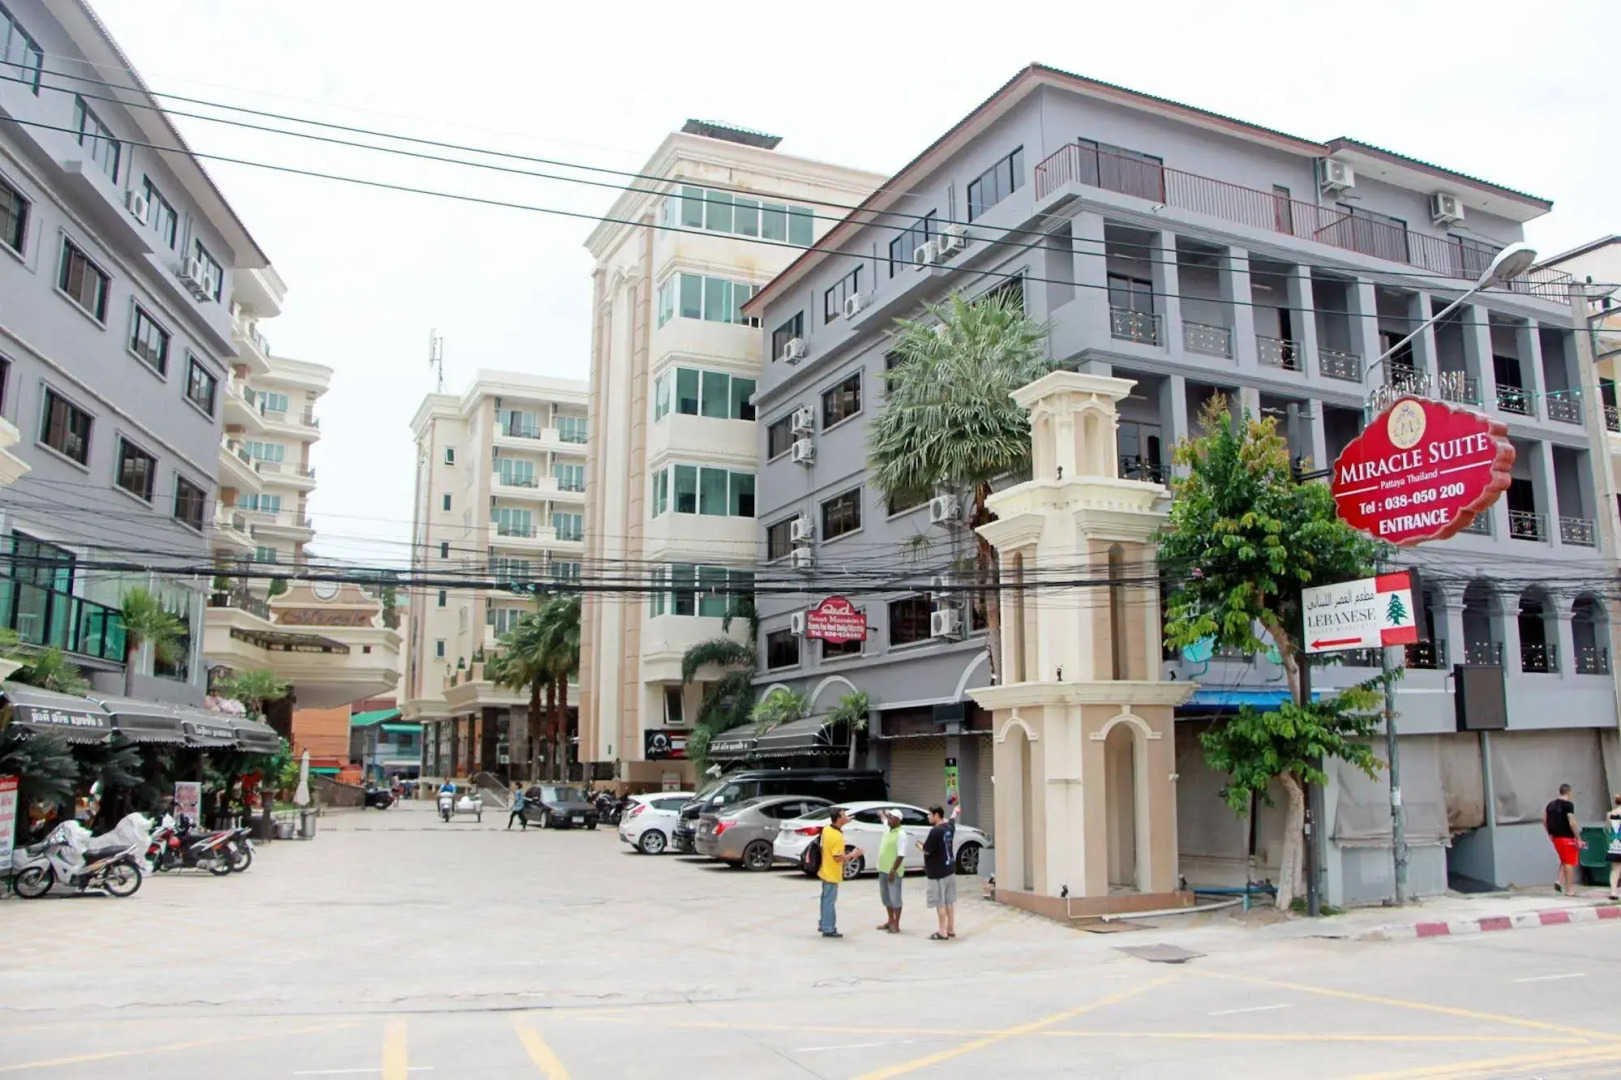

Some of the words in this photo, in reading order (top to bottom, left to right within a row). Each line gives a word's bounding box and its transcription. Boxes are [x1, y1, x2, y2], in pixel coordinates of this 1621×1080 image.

[1340, 449, 1423, 485] MIRACLE
[1428, 432, 1488, 464] SUITE
[1380, 478, 1405, 490] Pattaya
[1407, 469, 1438, 484] Thailand
[1384, 489, 1437, 511] 038-050
[1440, 481, 1465, 499] 200
[1379, 507, 1450, 534] ENTRANCE
[1308, 607, 1376, 628] LEBANESE
